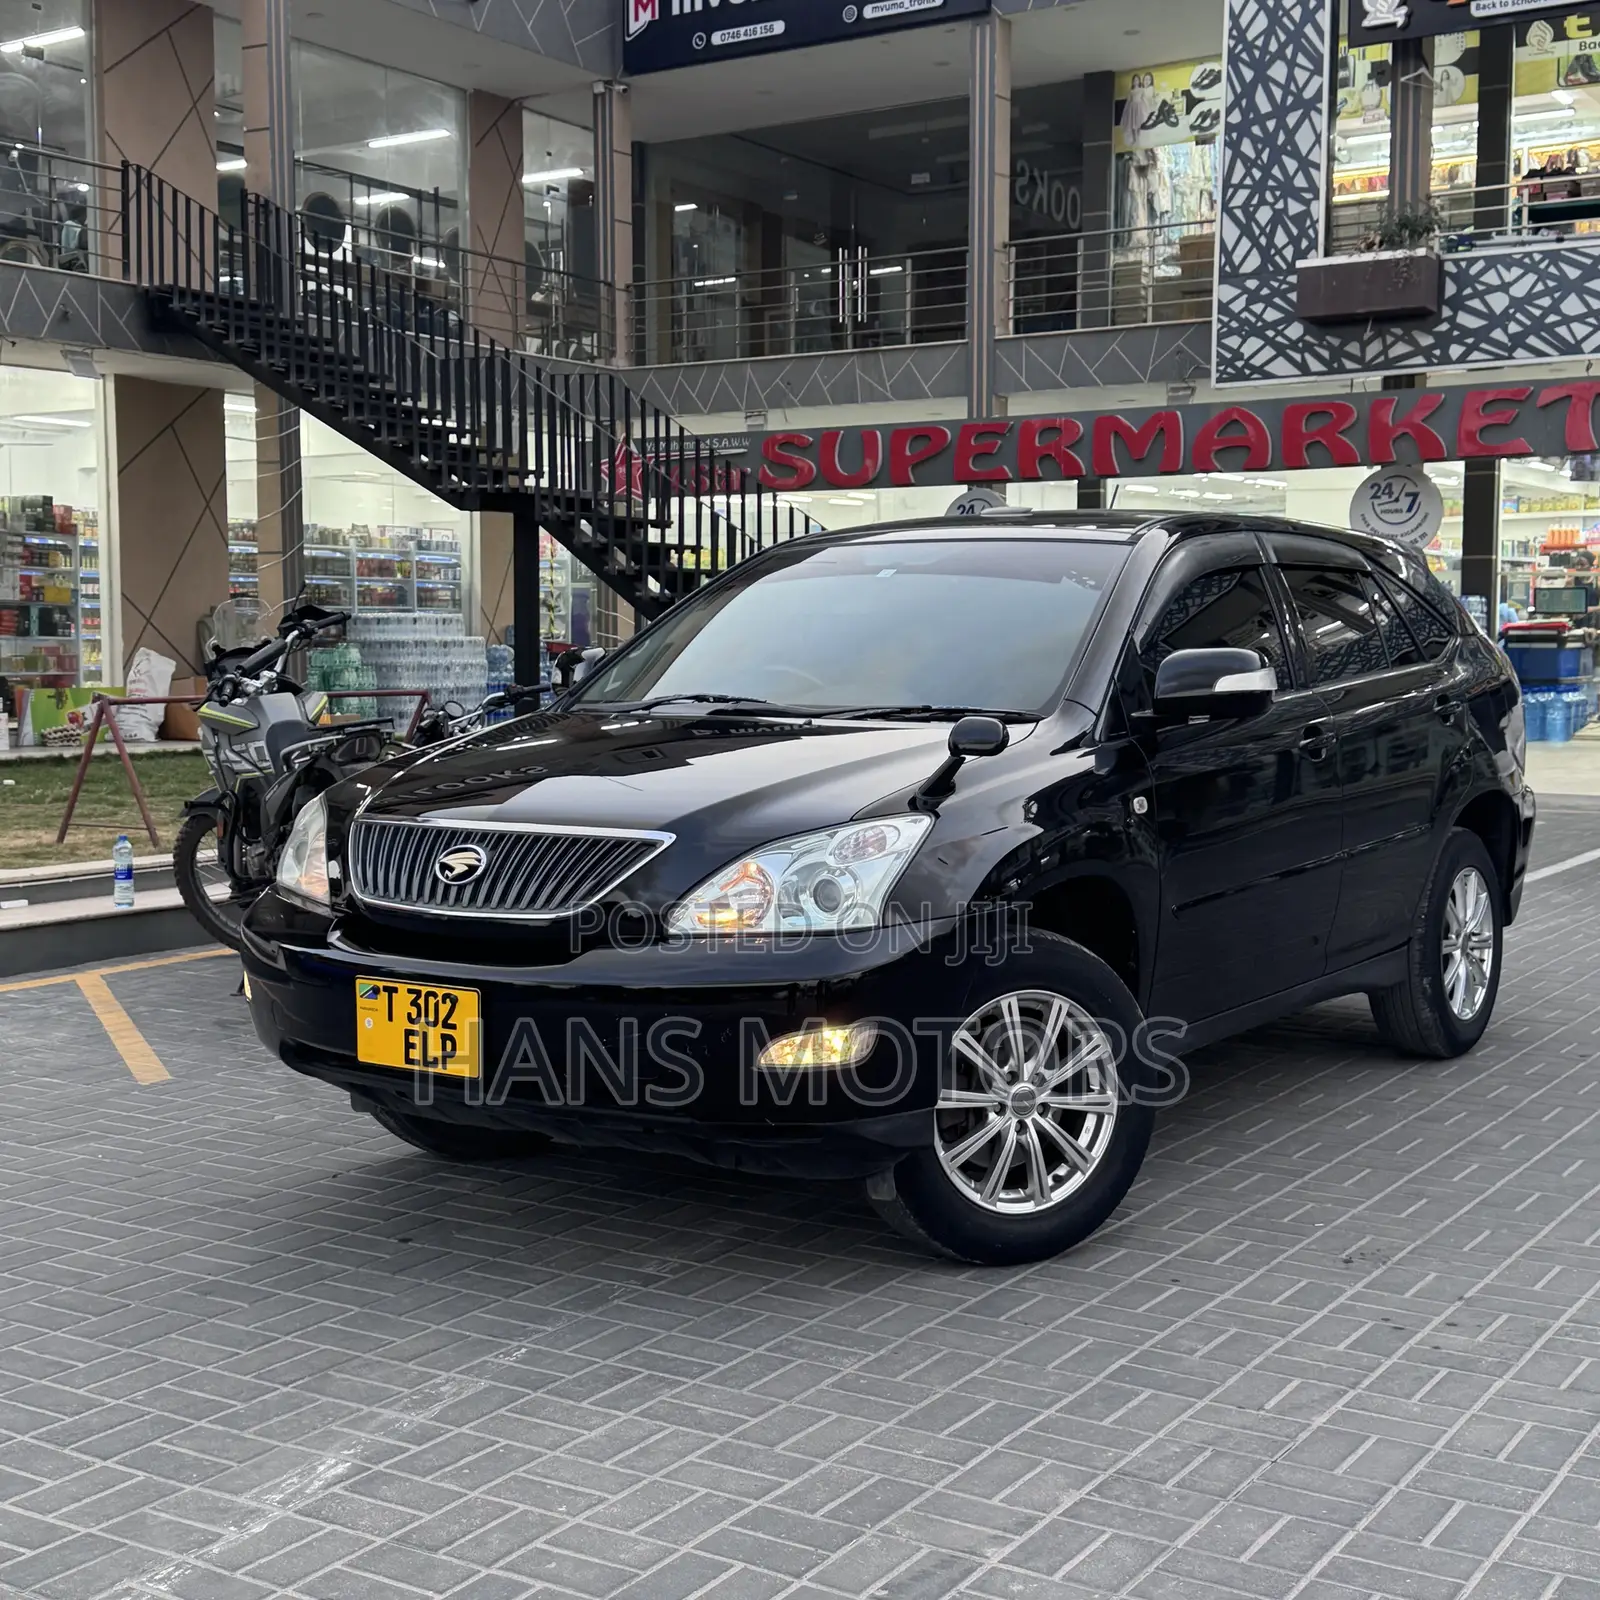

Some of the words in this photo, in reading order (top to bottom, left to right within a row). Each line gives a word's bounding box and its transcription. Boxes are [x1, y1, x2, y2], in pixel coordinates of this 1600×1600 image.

[1475, 2, 1497, 11] Back
[720, 28, 741, 42] 0746
[743, 26, 758, 38] 416
[759, 24, 775, 35] 156
[758, 381, 1600, 489] SUPERMARKET
[382, 985, 398, 1022] T
[407, 988, 459, 1030] 302
[404, 1028, 457, 1070] ELP
